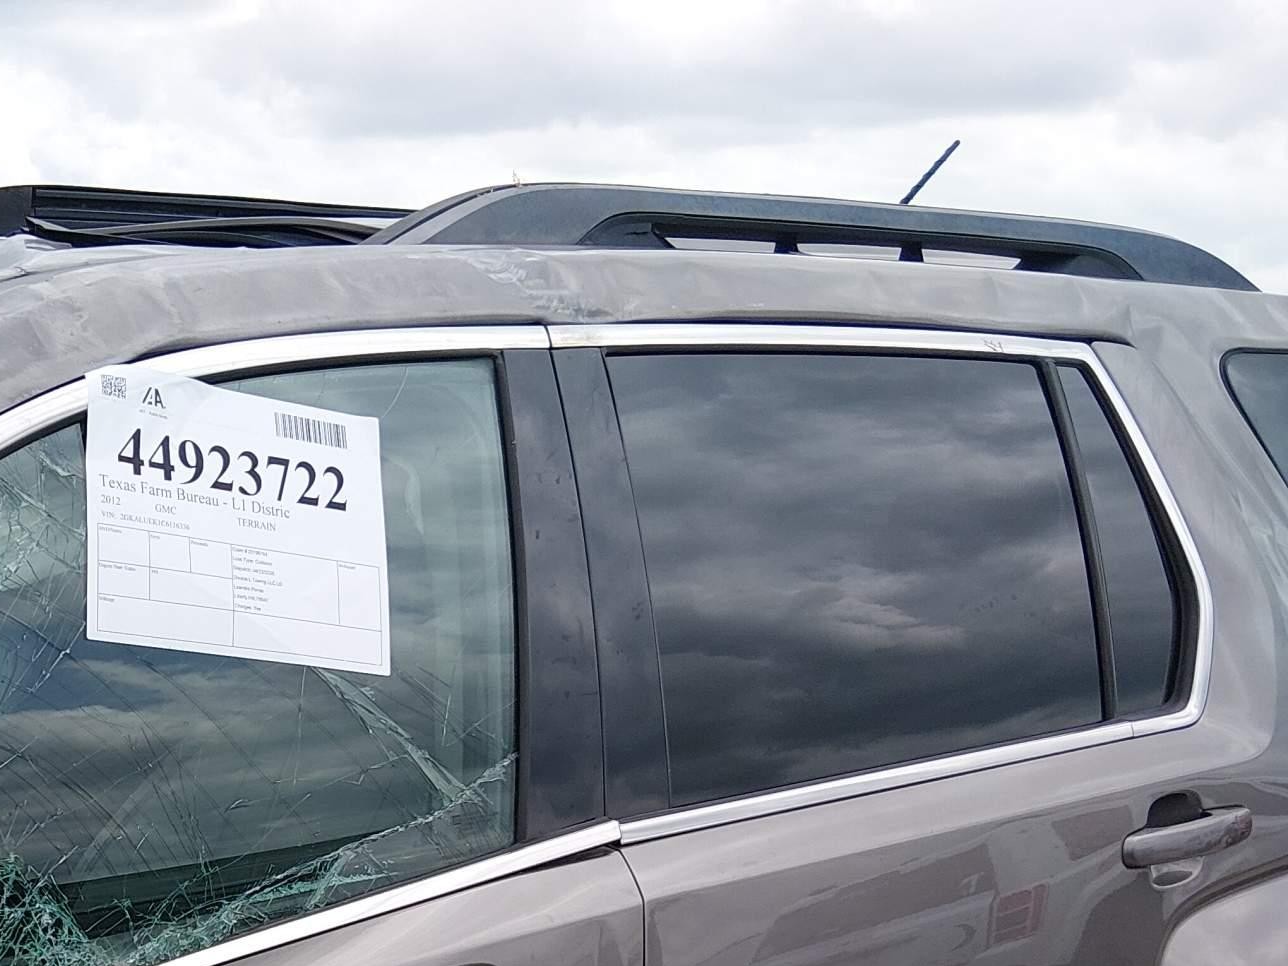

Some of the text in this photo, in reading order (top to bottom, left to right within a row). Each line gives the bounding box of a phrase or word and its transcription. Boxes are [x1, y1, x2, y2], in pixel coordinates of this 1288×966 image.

[117, 427, 348, 512] 44923722
[99, 473, 137, 493] Texas
[140, 481, 173, 500] Farm
[176, 487, 220, 507] Bureau
[252, 501, 291, 519] Distric
[100, 494, 121, 506] 2012
[155, 503, 177, 515] GMC
[237, 517, 276, 532] TERRAIN
